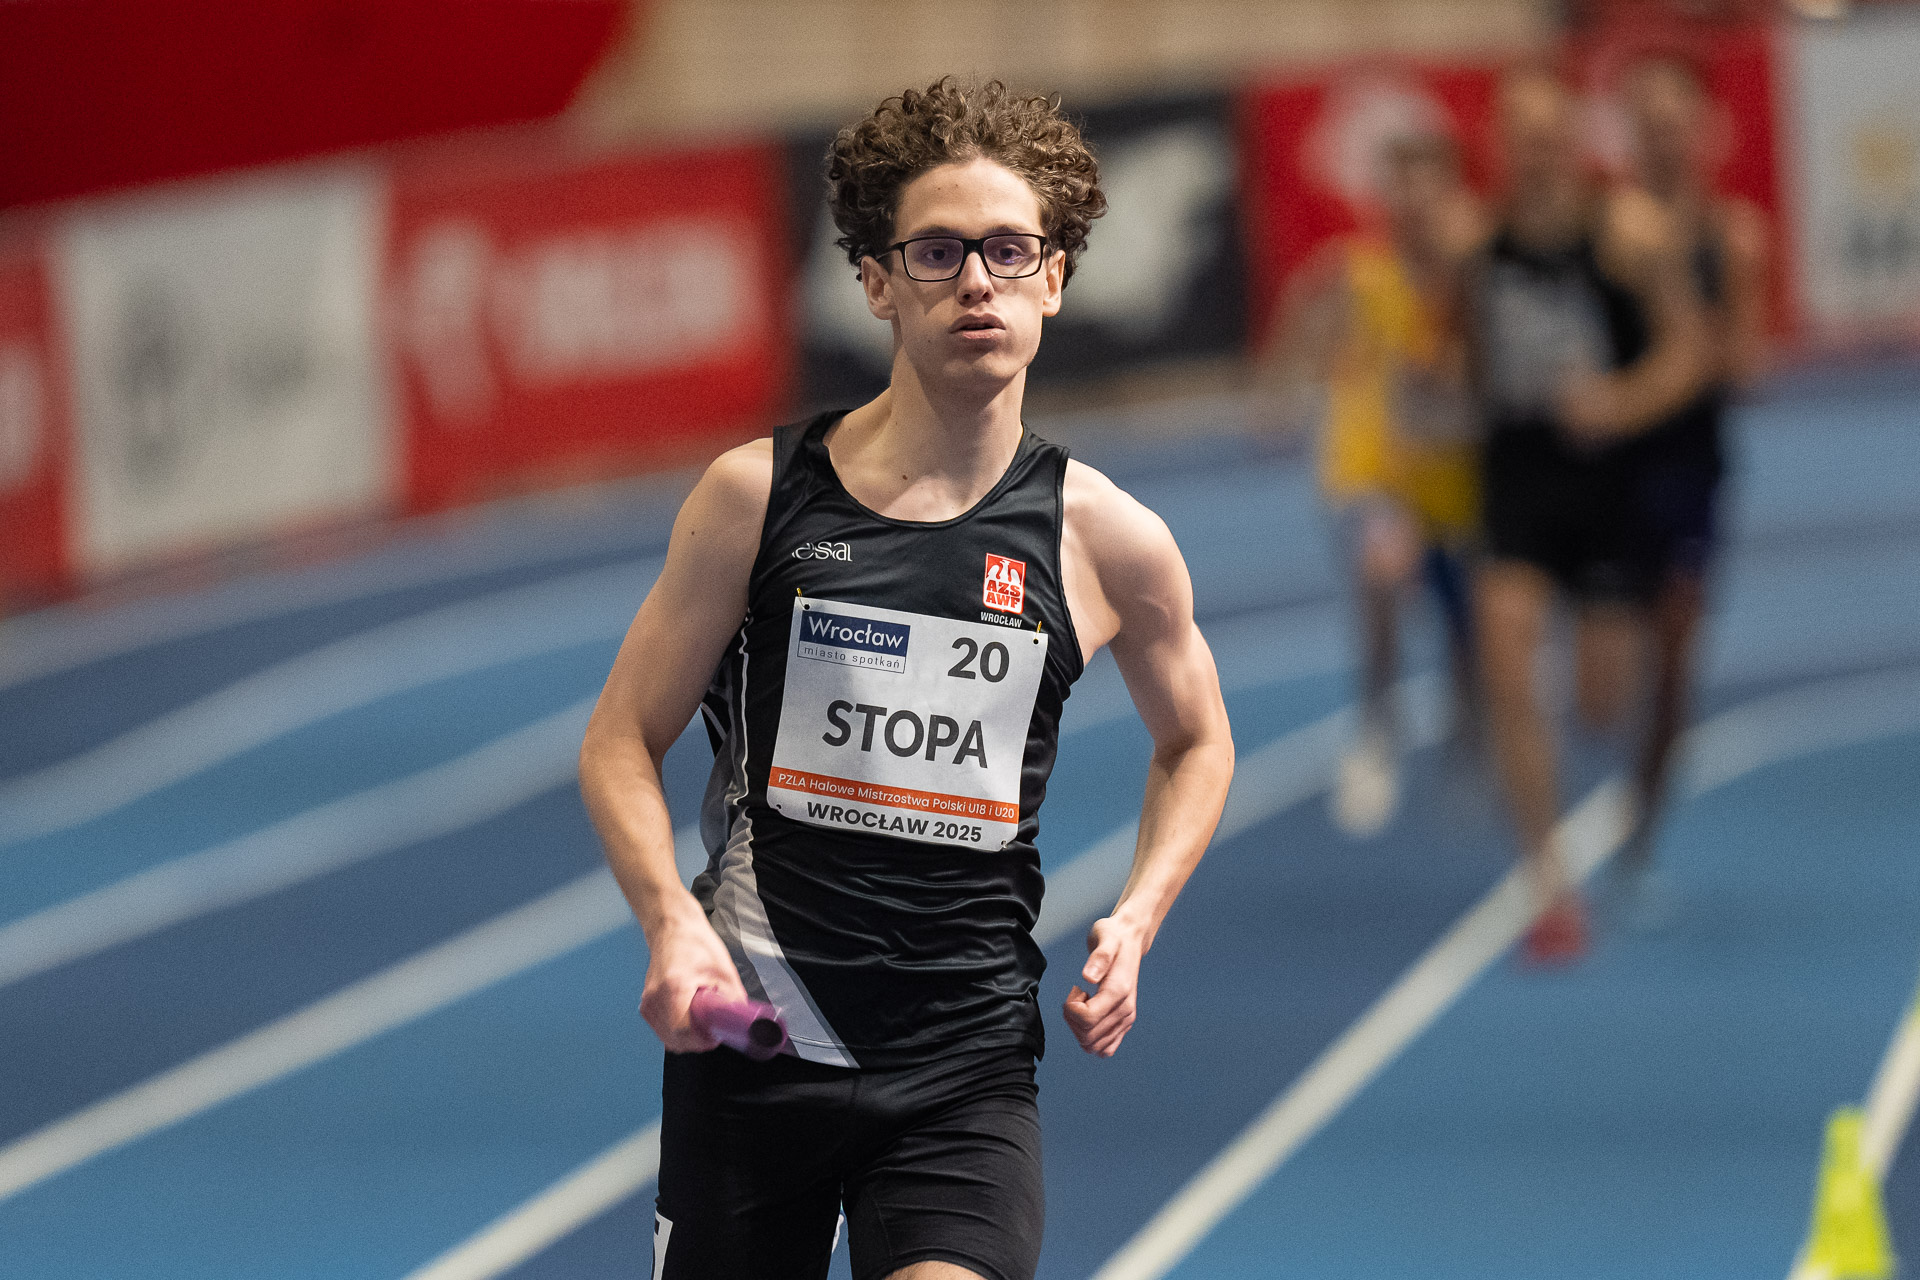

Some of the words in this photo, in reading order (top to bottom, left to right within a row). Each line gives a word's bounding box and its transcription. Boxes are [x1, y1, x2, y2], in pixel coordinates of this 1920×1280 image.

[985, 591, 1021, 609] AWF
[986, 579, 1021, 597] AZS
[808, 615, 904, 649] Wrocław
[980, 611, 1022, 628] WROCŁAW
[804, 646, 846, 660] miasto
[852, 655, 900, 669] spotkań
[947, 637, 1010, 683] 20
[821, 699, 988, 769] STOPA
[778, 773, 806, 787] PZLA
[809, 778, 855, 796] Halowe
[857, 787, 930, 807] Mistrzostwa
[932, 798, 966, 812] Polski
[968, 803, 986, 815] U18
[994, 806, 1015, 819] U20
[807, 801, 930, 836] WROCŁAW
[933, 821, 982, 842] 2025
